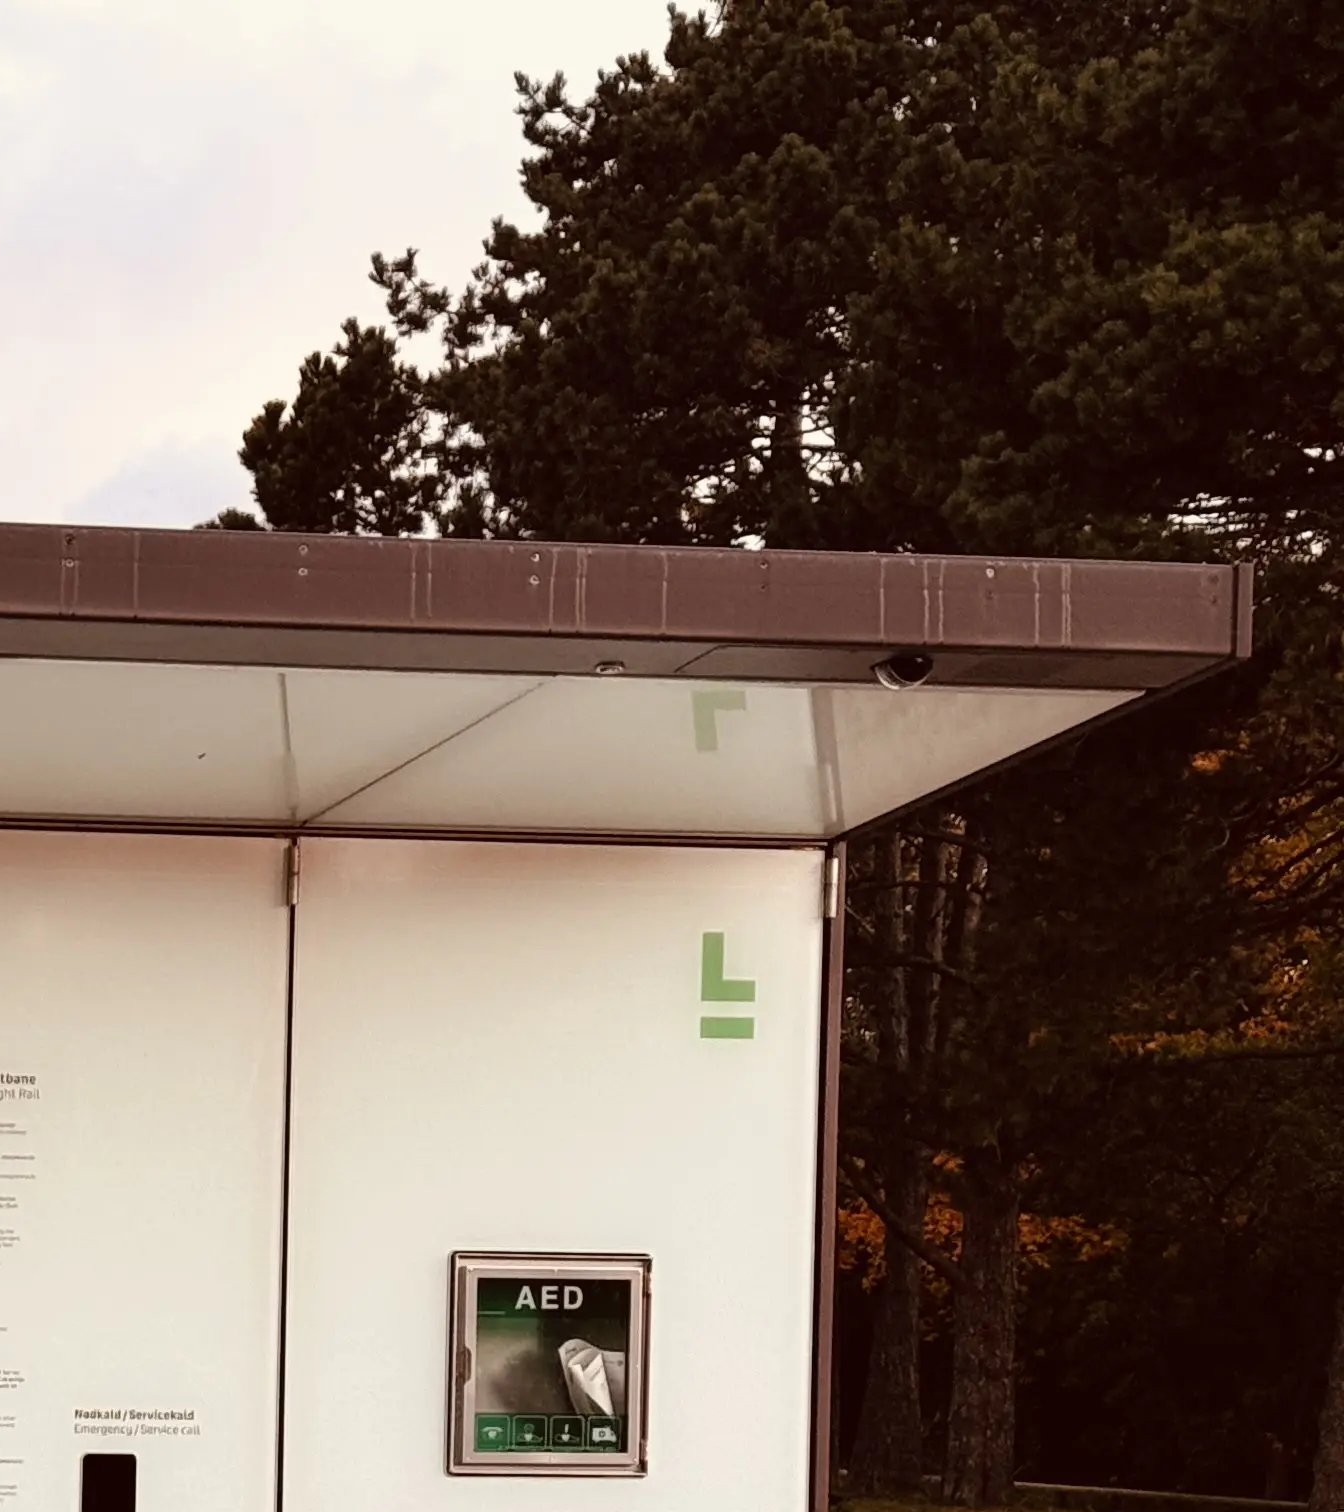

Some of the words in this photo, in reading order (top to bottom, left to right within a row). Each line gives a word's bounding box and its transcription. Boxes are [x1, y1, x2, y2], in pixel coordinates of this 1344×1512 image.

[515, 1286, 584, 1310] AED
[129, 1409, 194, 1420] Servicekald
[74, 1424, 132, 1436] Emergency
[181, 1425, 200, 1435] call
